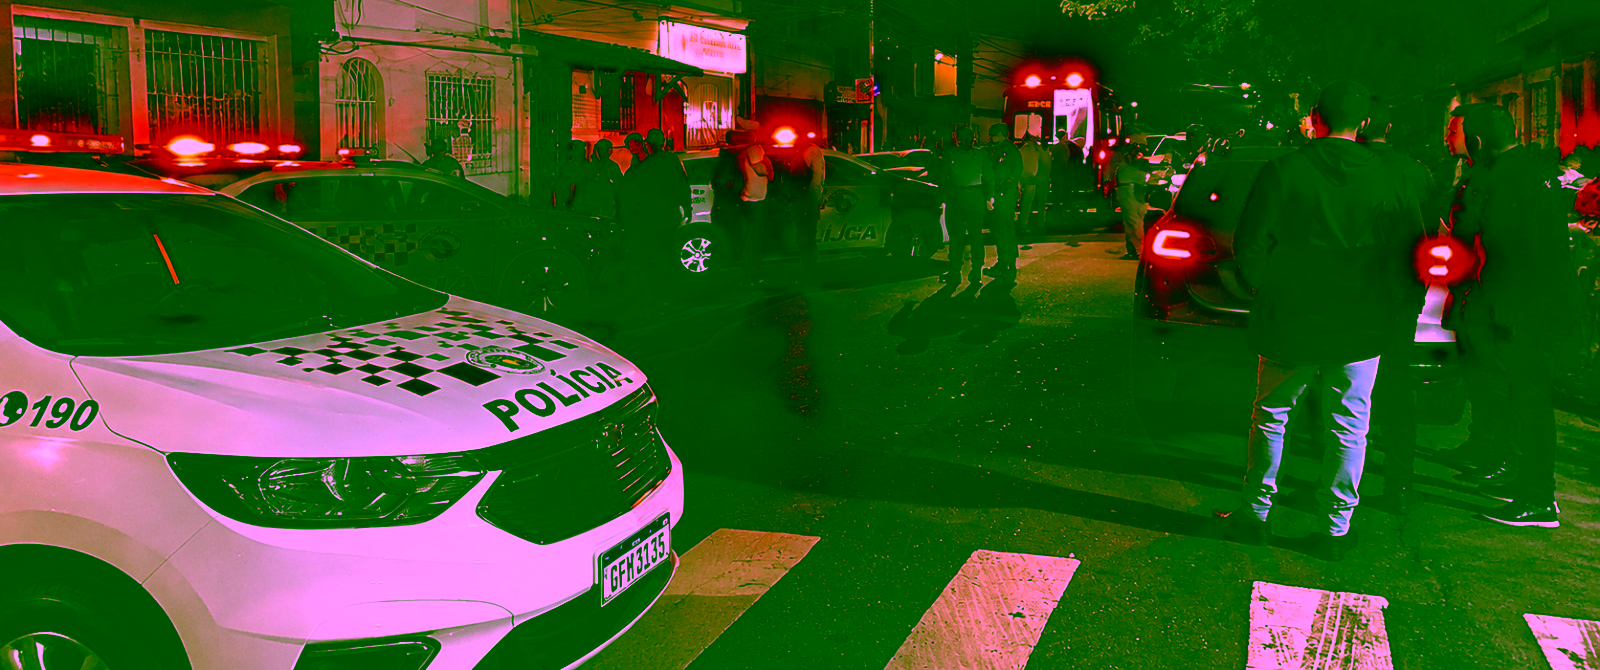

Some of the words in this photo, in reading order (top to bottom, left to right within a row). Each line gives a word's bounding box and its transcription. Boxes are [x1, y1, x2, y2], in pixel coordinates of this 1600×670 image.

[816, 223, 877, 242] LÍCIA
[29, 395, 100, 432] 190
[481, 362, 634, 433] POLÍCIA
